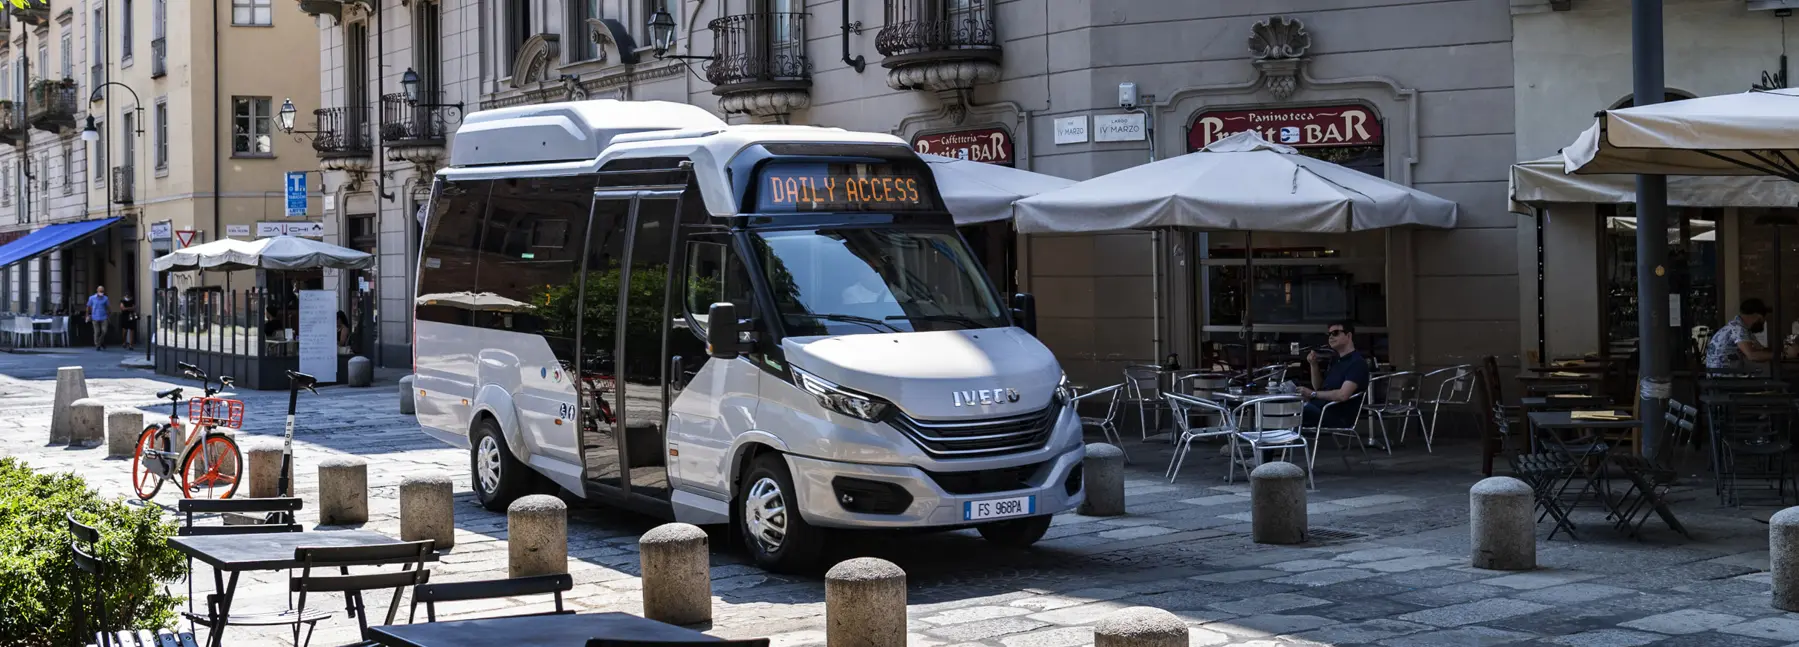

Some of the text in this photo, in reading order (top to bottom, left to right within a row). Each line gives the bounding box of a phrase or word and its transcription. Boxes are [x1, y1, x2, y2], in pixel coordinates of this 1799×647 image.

[1064, 127, 1084, 136] MARZO
[1100, 125, 1140, 134] IV MARZO
[1304, 110, 1371, 143] BAR
[940, 133, 977, 145] Caffetteria
[971, 132, 1007, 161] BAR
[770, 177, 919, 203] DAILY ACCESS
[952, 387, 1020, 407] IVECO
[978, 501, 990, 517] FS
[995, 500, 1022, 515] 968PA
